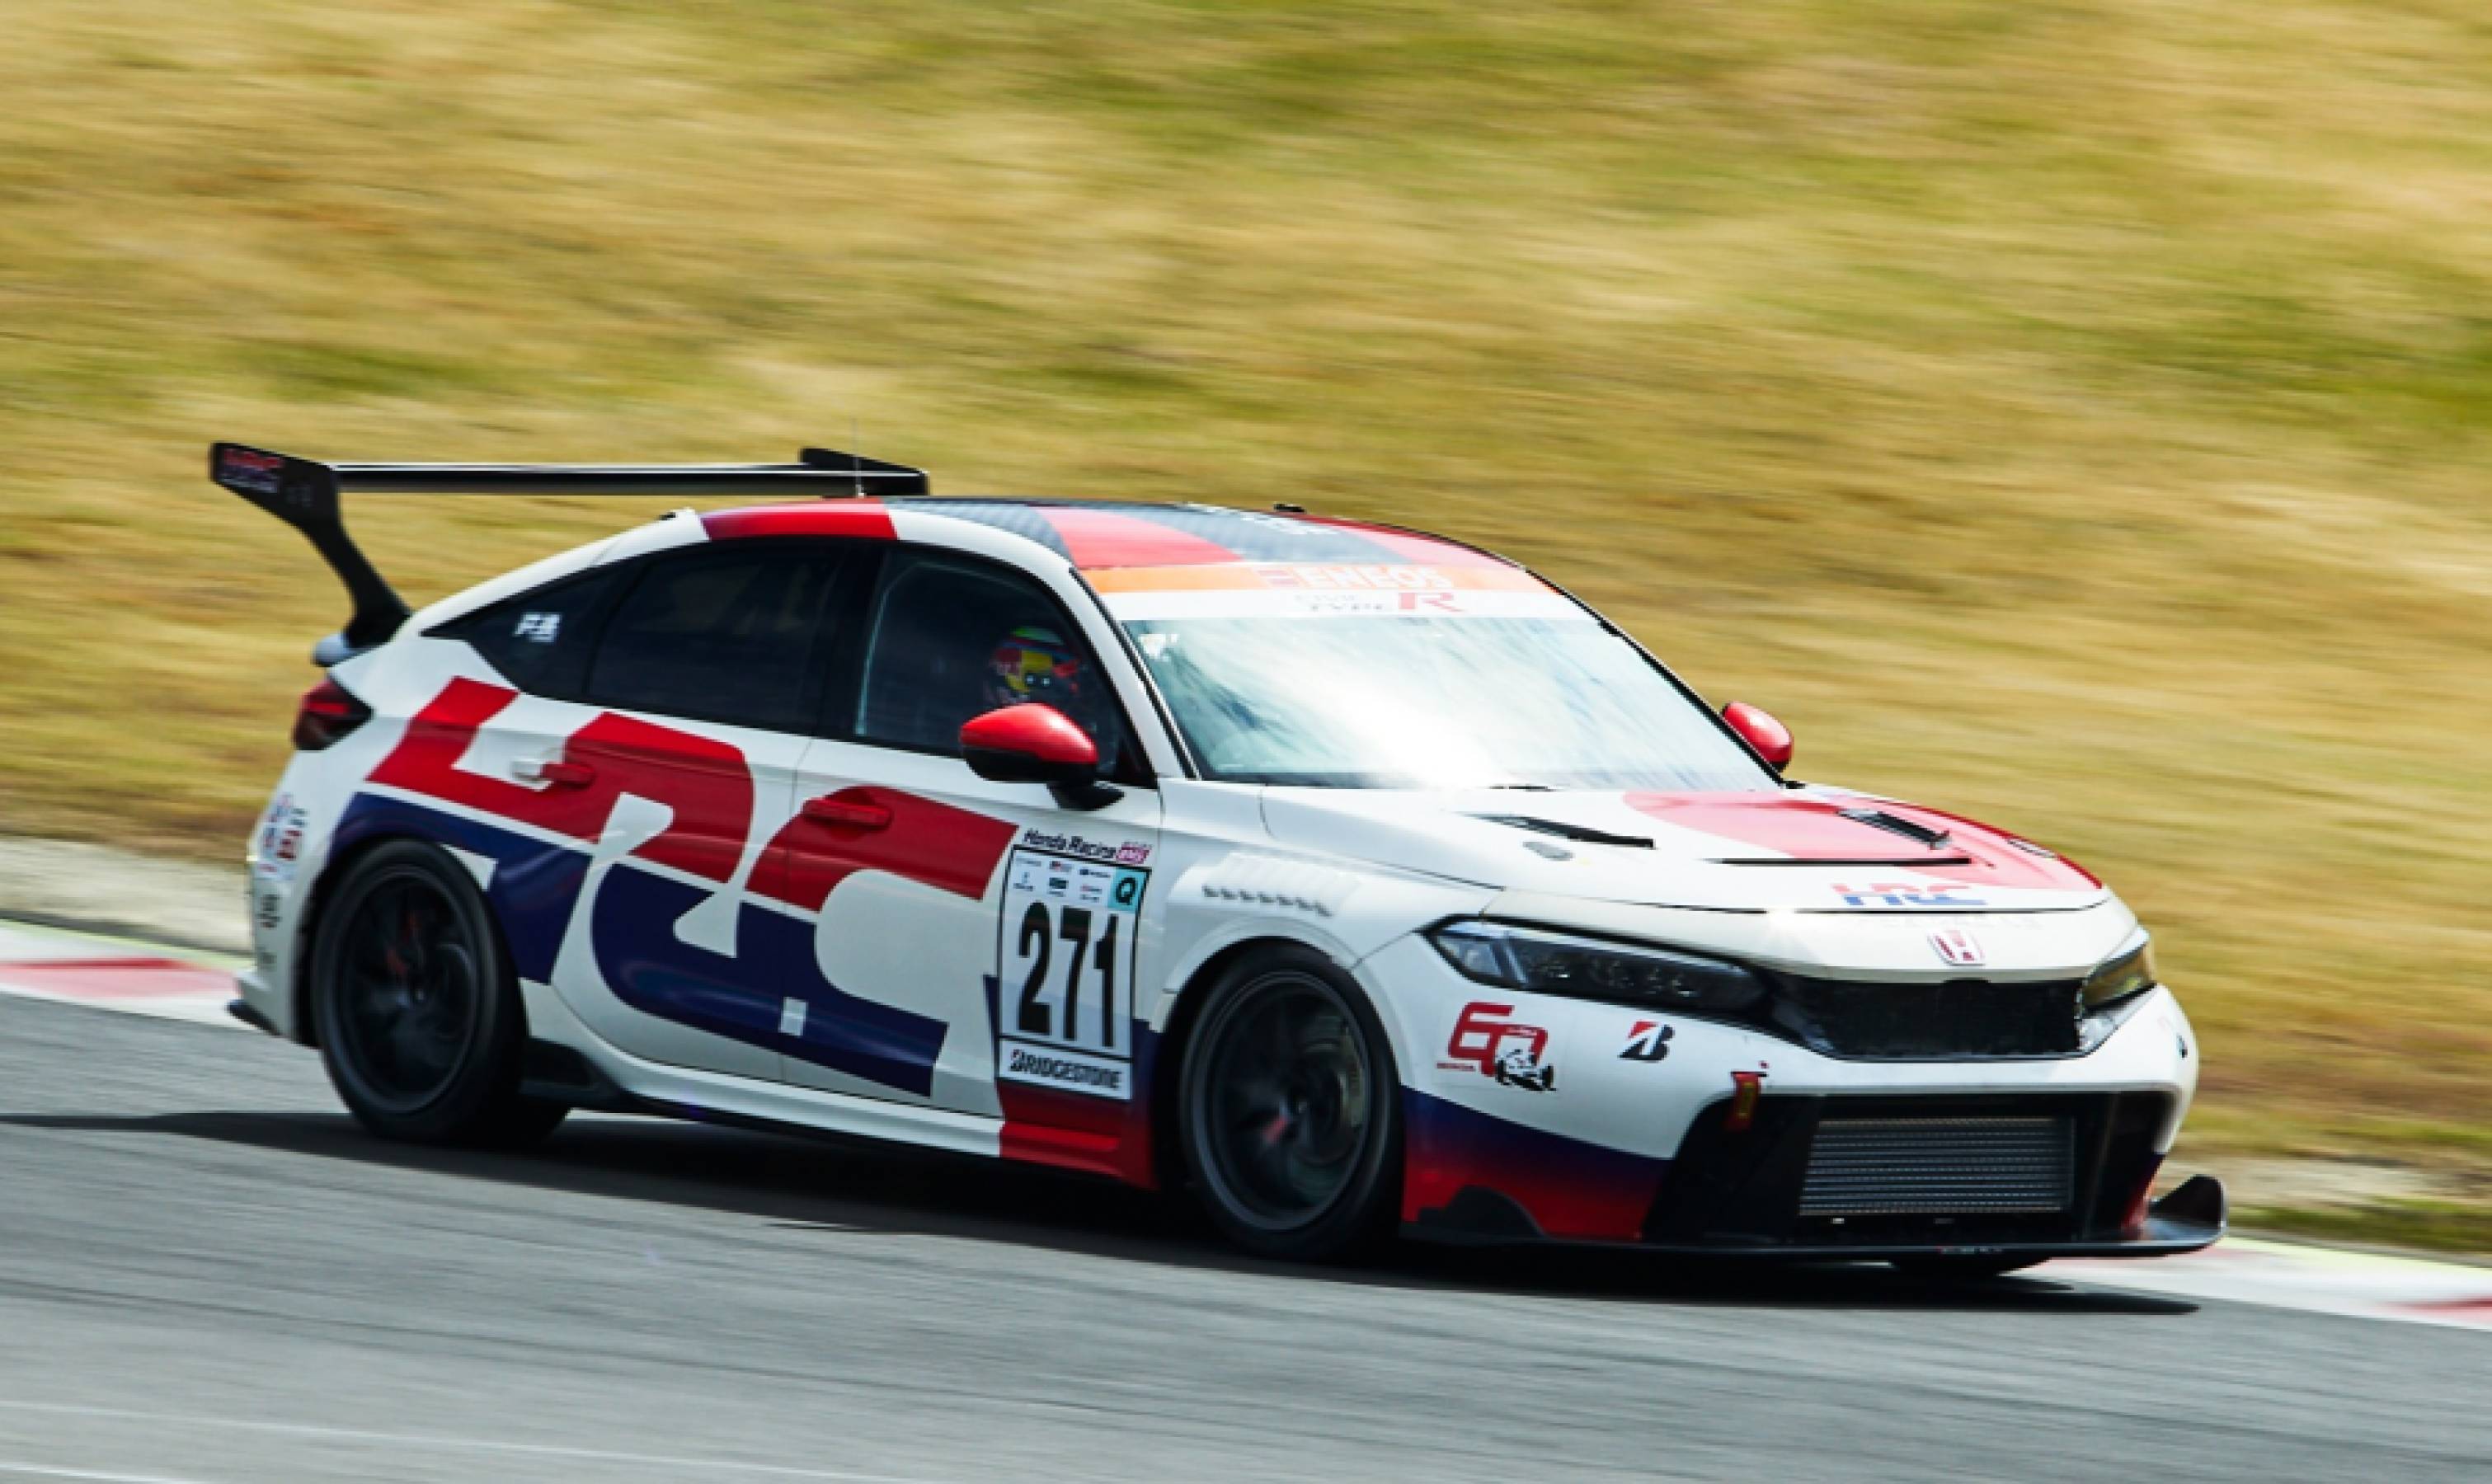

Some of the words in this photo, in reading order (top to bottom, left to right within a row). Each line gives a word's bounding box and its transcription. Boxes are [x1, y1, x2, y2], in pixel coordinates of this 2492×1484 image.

[1291, 565, 1455, 589] ENEOS
[1399, 591, 1463, 613] R
[1023, 828, 1067, 851] Honda
[1068, 835, 1117, 860] Racing
[1115, 877, 1136, 905] Q
[1830, 882, 1988, 906] HRC
[1018, 901, 1120, 1049] 271
[1009, 1049, 1122, 1090] BRIDGESTONE
